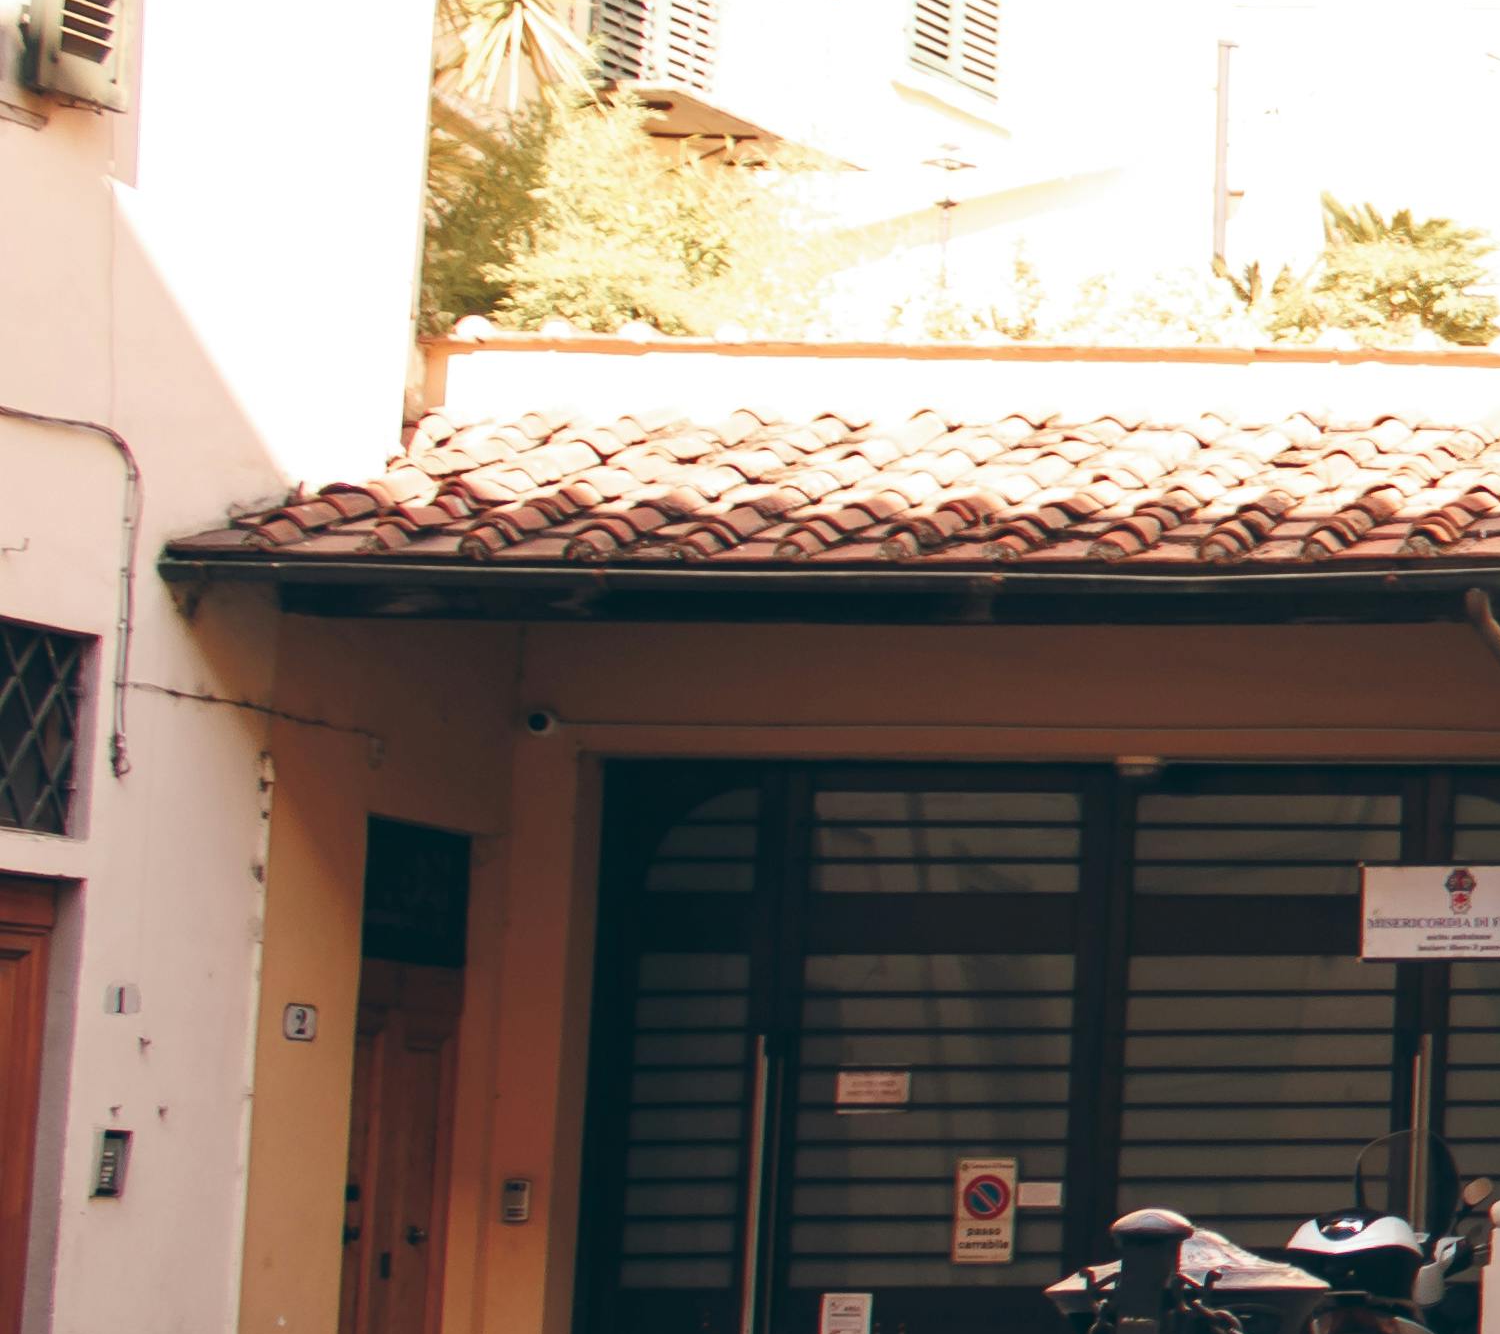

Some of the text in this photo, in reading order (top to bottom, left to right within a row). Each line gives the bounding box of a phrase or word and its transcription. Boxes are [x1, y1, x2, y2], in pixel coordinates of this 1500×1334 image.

[1368, 918, 1471, 929] MISERICORDIA
[1474, 917, 1488, 927] DI
[294, 1009, 307, 1035] 2
[966, 1228, 1001, 1236] passo
[958, 1241, 1009, 1250] carrabile
